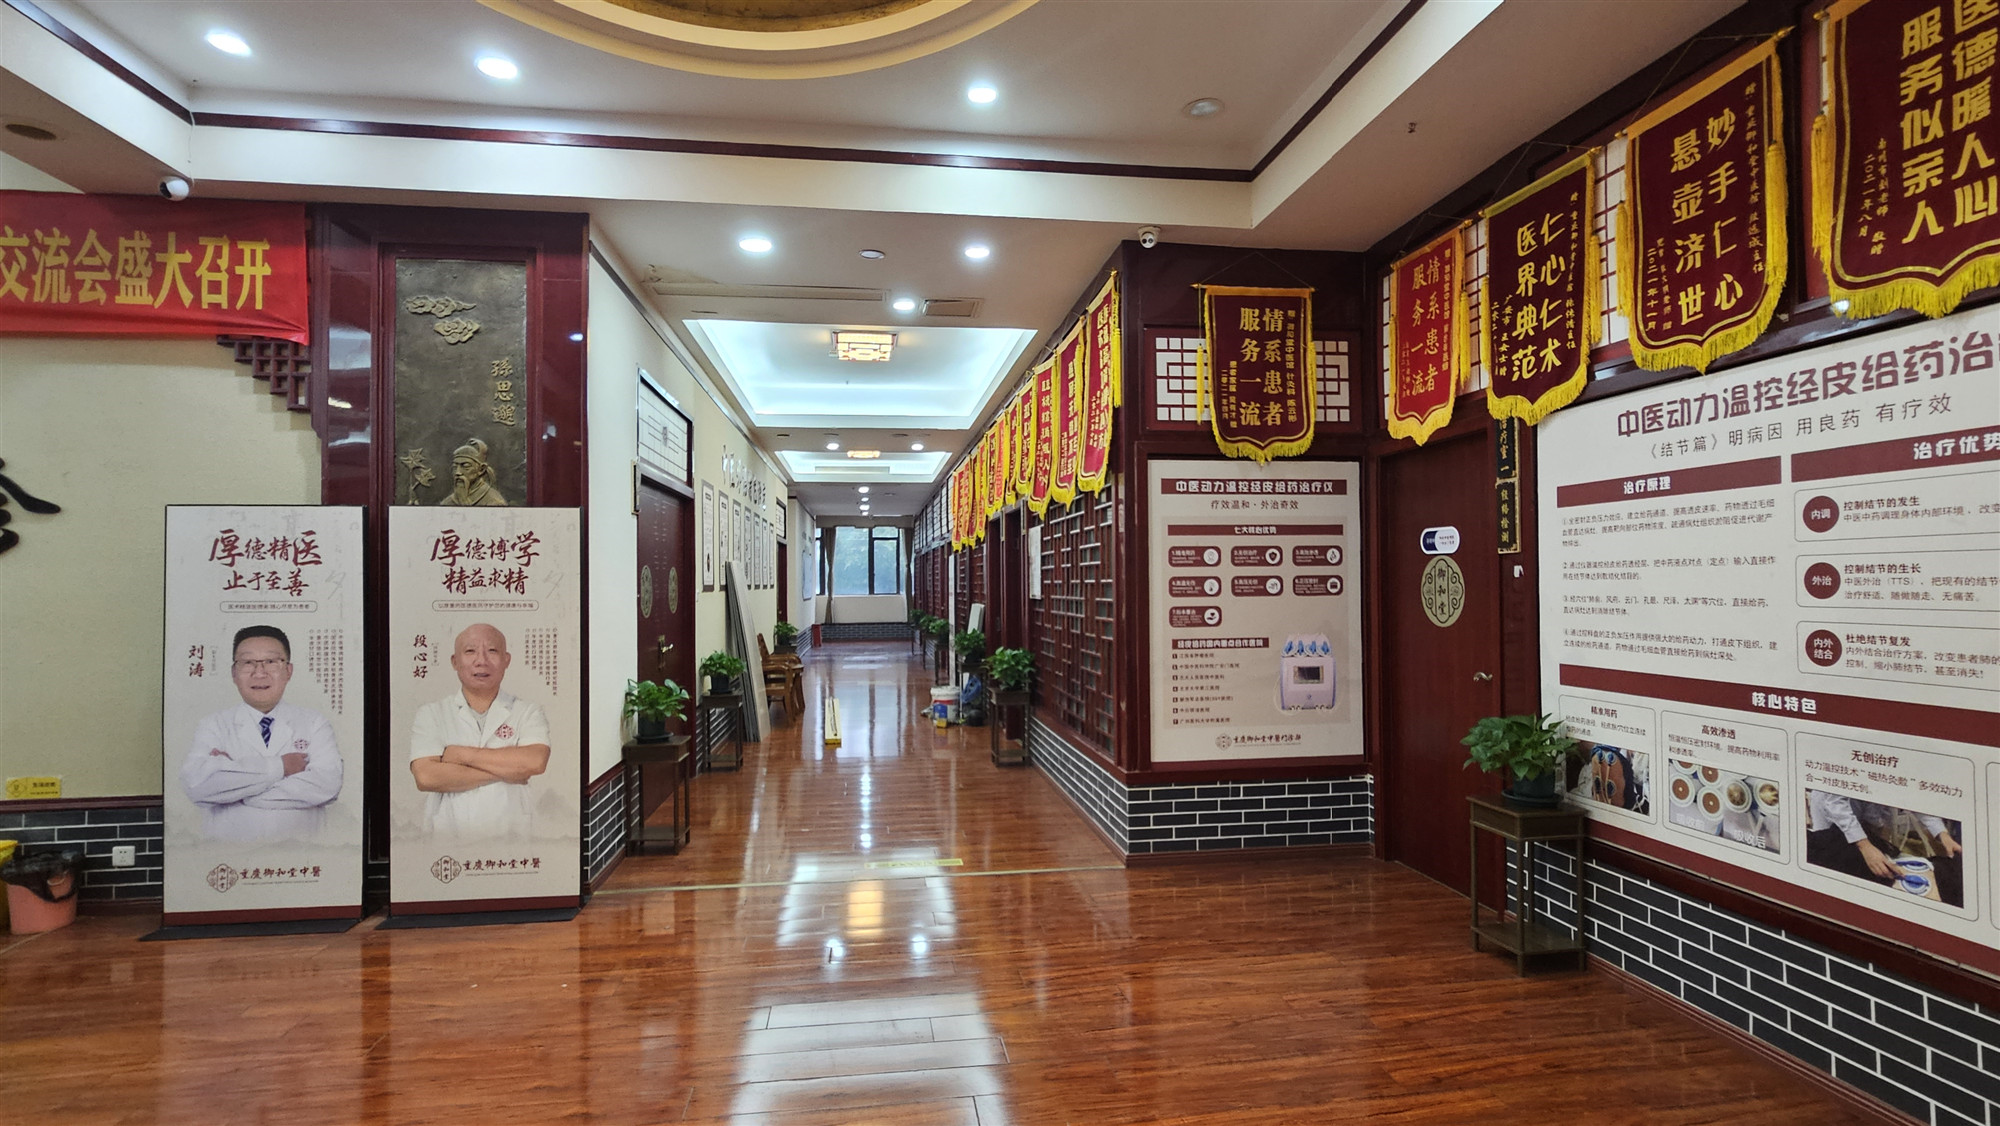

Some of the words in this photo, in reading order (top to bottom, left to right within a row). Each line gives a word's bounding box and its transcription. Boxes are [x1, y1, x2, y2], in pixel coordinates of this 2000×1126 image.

[1900, 6, 1944, 244] 服务似亲人
[1952, 0, 2000, 227] 医德暖人心
[1670, 128, 1704, 325] 悬壶济世
[1706, 108, 1743, 312] 妙手仁心
[0, 225, 271, 310] 交流会盛大召开
[1511, 221, 1538, 382] 医界典范
[1539, 212, 1565, 373] 仁心仁术
[1411, 263, 1427, 396] 服务一流
[1425, 256, 1440, 391] 情系患者
[1239, 307, 1261, 426] 服务一流
[1262, 307, 1284, 426] 情系患者
[1176, 480, 1333, 493] 中医动力温控经皮给药治疗仪
[1623, 475, 1671, 494] 治疗原理
[1810, 509, 1831, 520] 内调
[1843, 495, 1920, 511] 控制结节的发生
[209, 529, 323, 568] 厚德精医
[430, 529, 541, 567] 厚德博学
[223, 567, 310, 597] 止于至善
[442, 566, 528, 595] 精益求精
[1812, 575, 1832, 586] 外治
[1844, 563, 1921, 574] 控制结节的生长
[413, 634, 428, 679] 段心好
[1813, 638, 1833, 649] 内外
[1814, 649, 1834, 660] 结合
[1846, 633, 1911, 647] 杜绝结节复发
[189, 645, 205, 678] 刘涛
[1752, 691, 1817, 715] 核心特色
[1701, 724, 1736, 740] 高效渗透
[1850, 750, 1900, 769] 无创治疗
